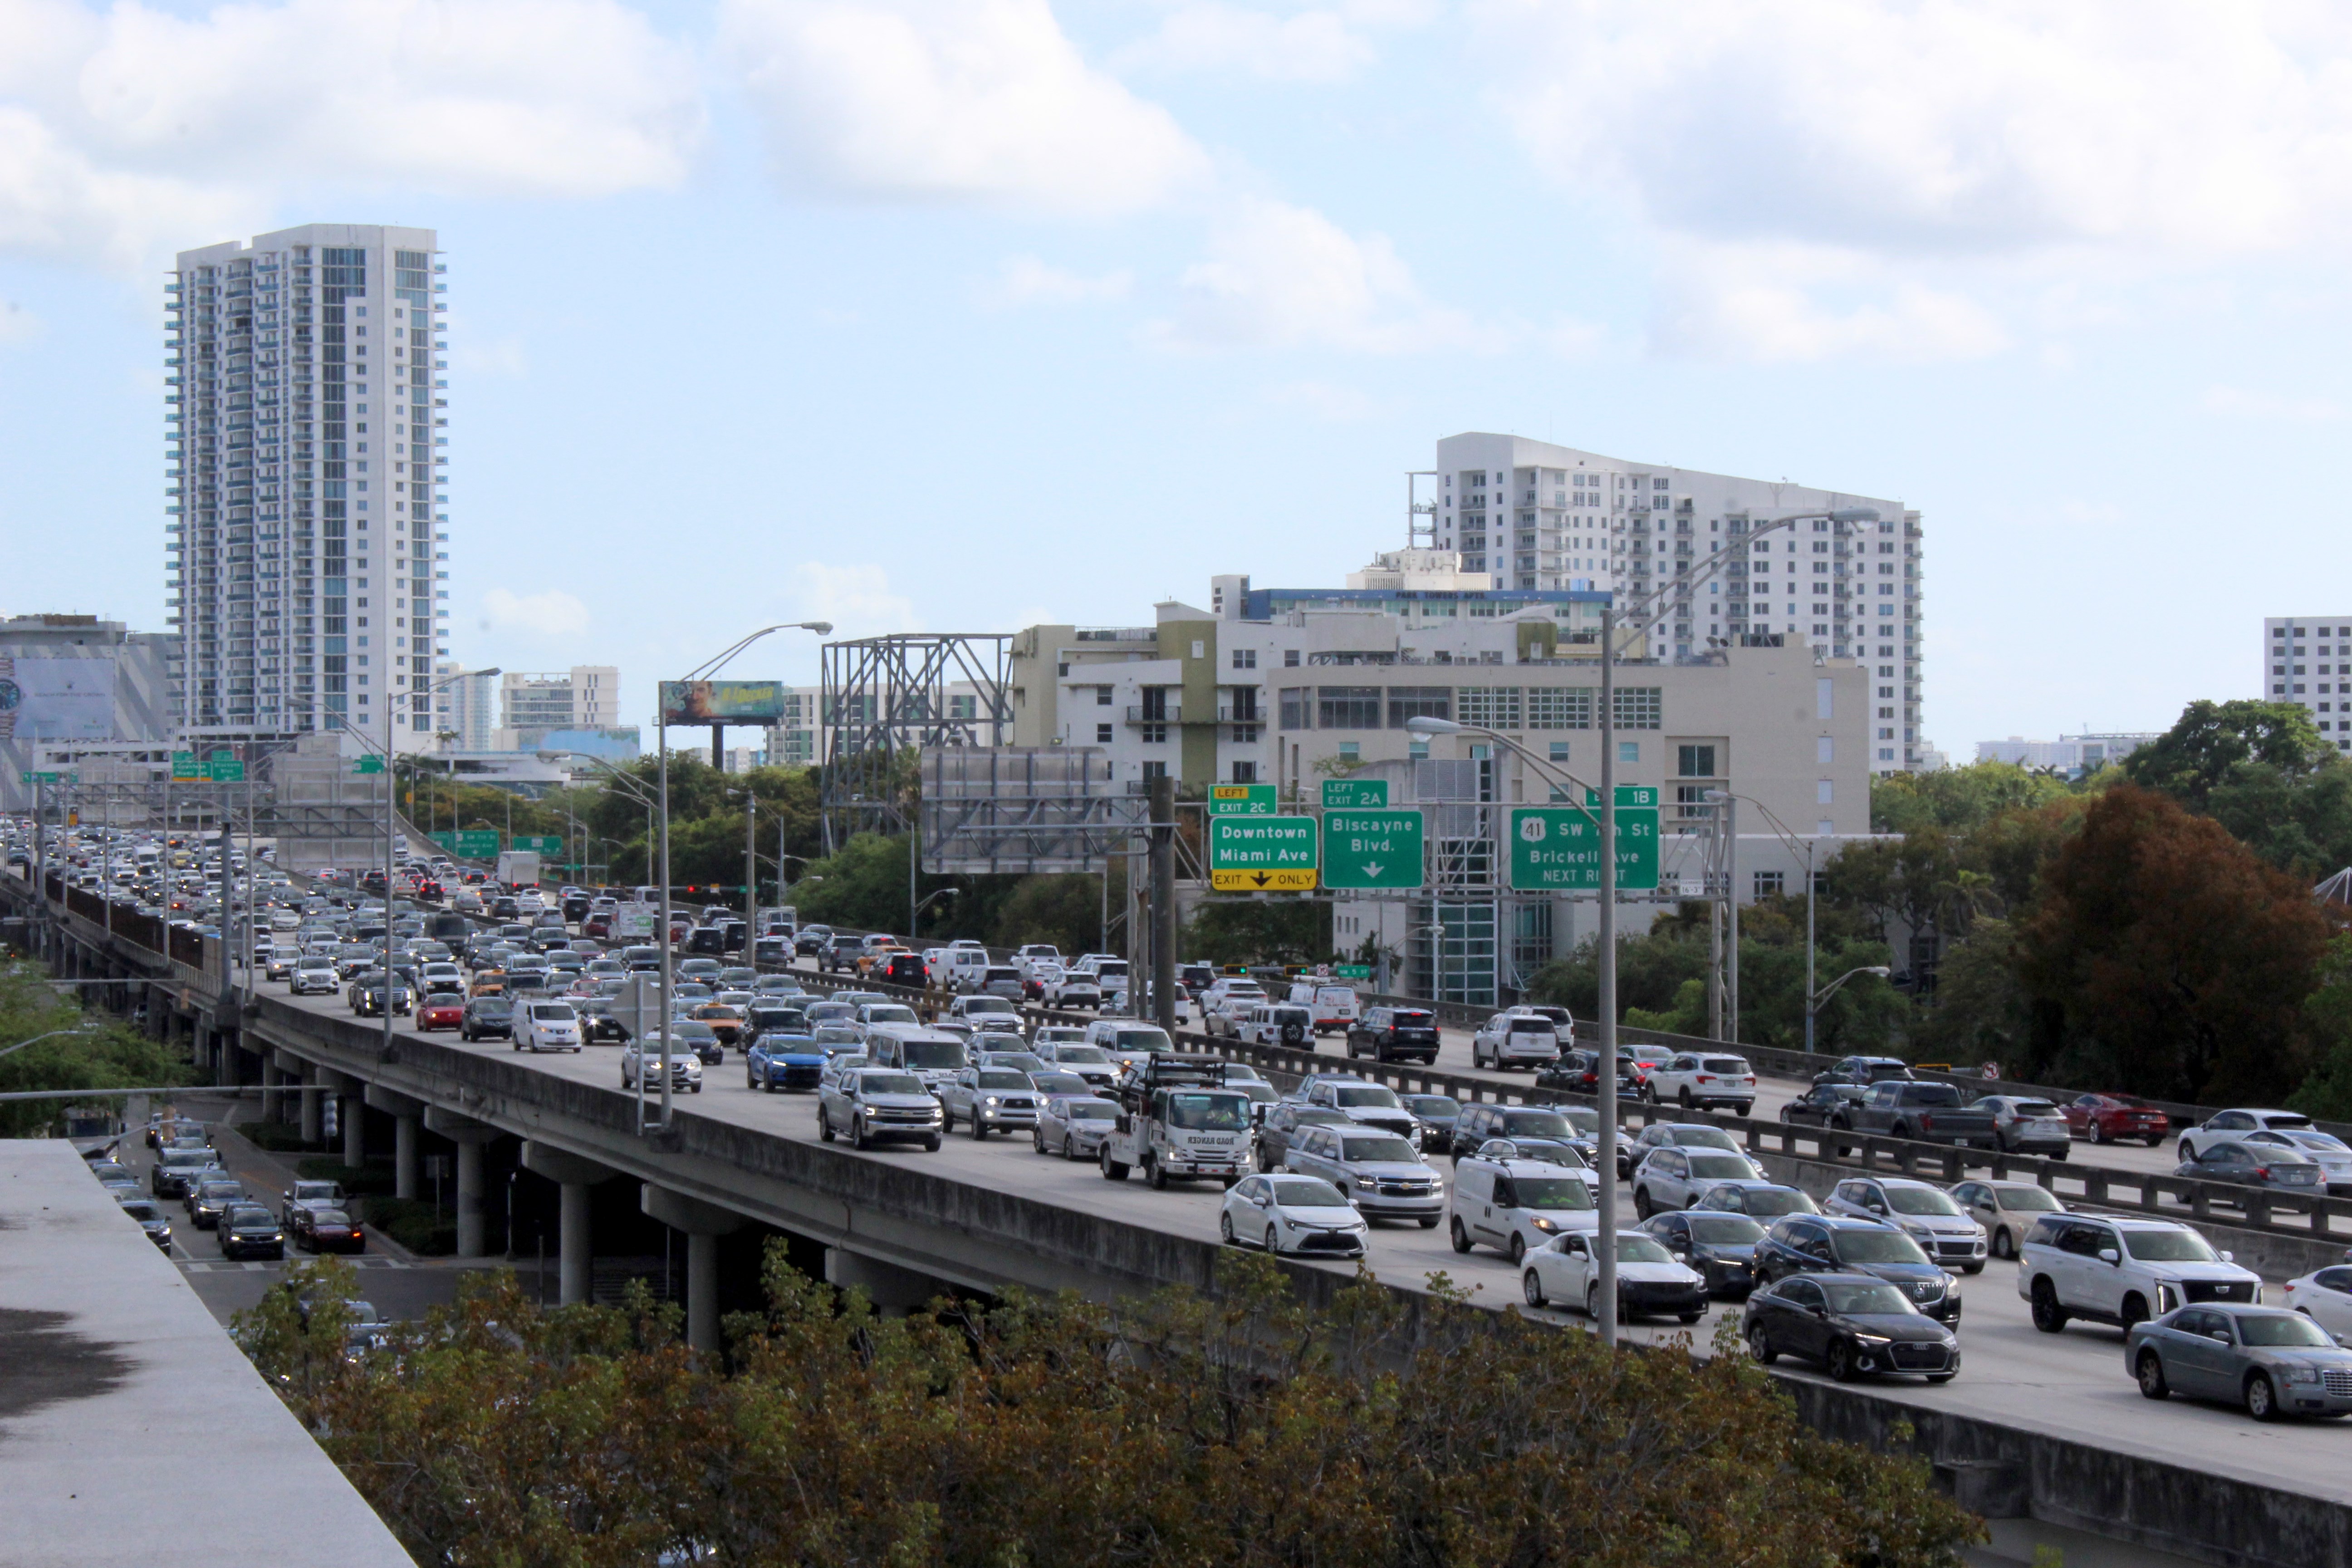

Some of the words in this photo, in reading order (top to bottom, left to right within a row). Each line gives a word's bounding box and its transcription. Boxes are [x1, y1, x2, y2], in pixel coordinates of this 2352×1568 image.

[1218, 788, 1244, 797] LEFT
[1328, 784, 1354, 792] LEFT
[1328, 796, 1352, 805] EXIT
[1360, 793, 1382, 805] 2A
[1633, 791, 1649, 804] 1B
[1219, 803, 1243, 813] EXIT
[1250, 802, 1266, 813] 2C
[1221, 826, 1307, 839] Downtown
[1332, 818, 1413, 834] Biscayne
[1525, 823, 1540, 836] 41
[1558, 823, 1583, 836] SW
[1631, 823, 1650, 836] St
[1351, 838, 1395, 852] Blvd.
[1220, 848, 1271, 862] Miami
[1277, 848, 1308, 862] Ave
[1530, 850, 1598, 863] Brickell
[1215, 875, 1242, 885] EXIT
[1278, 875, 1313, 885] ONLY
[1543, 869, 1577, 882] NEXT
[1586, 869, 1626, 882] RIT
